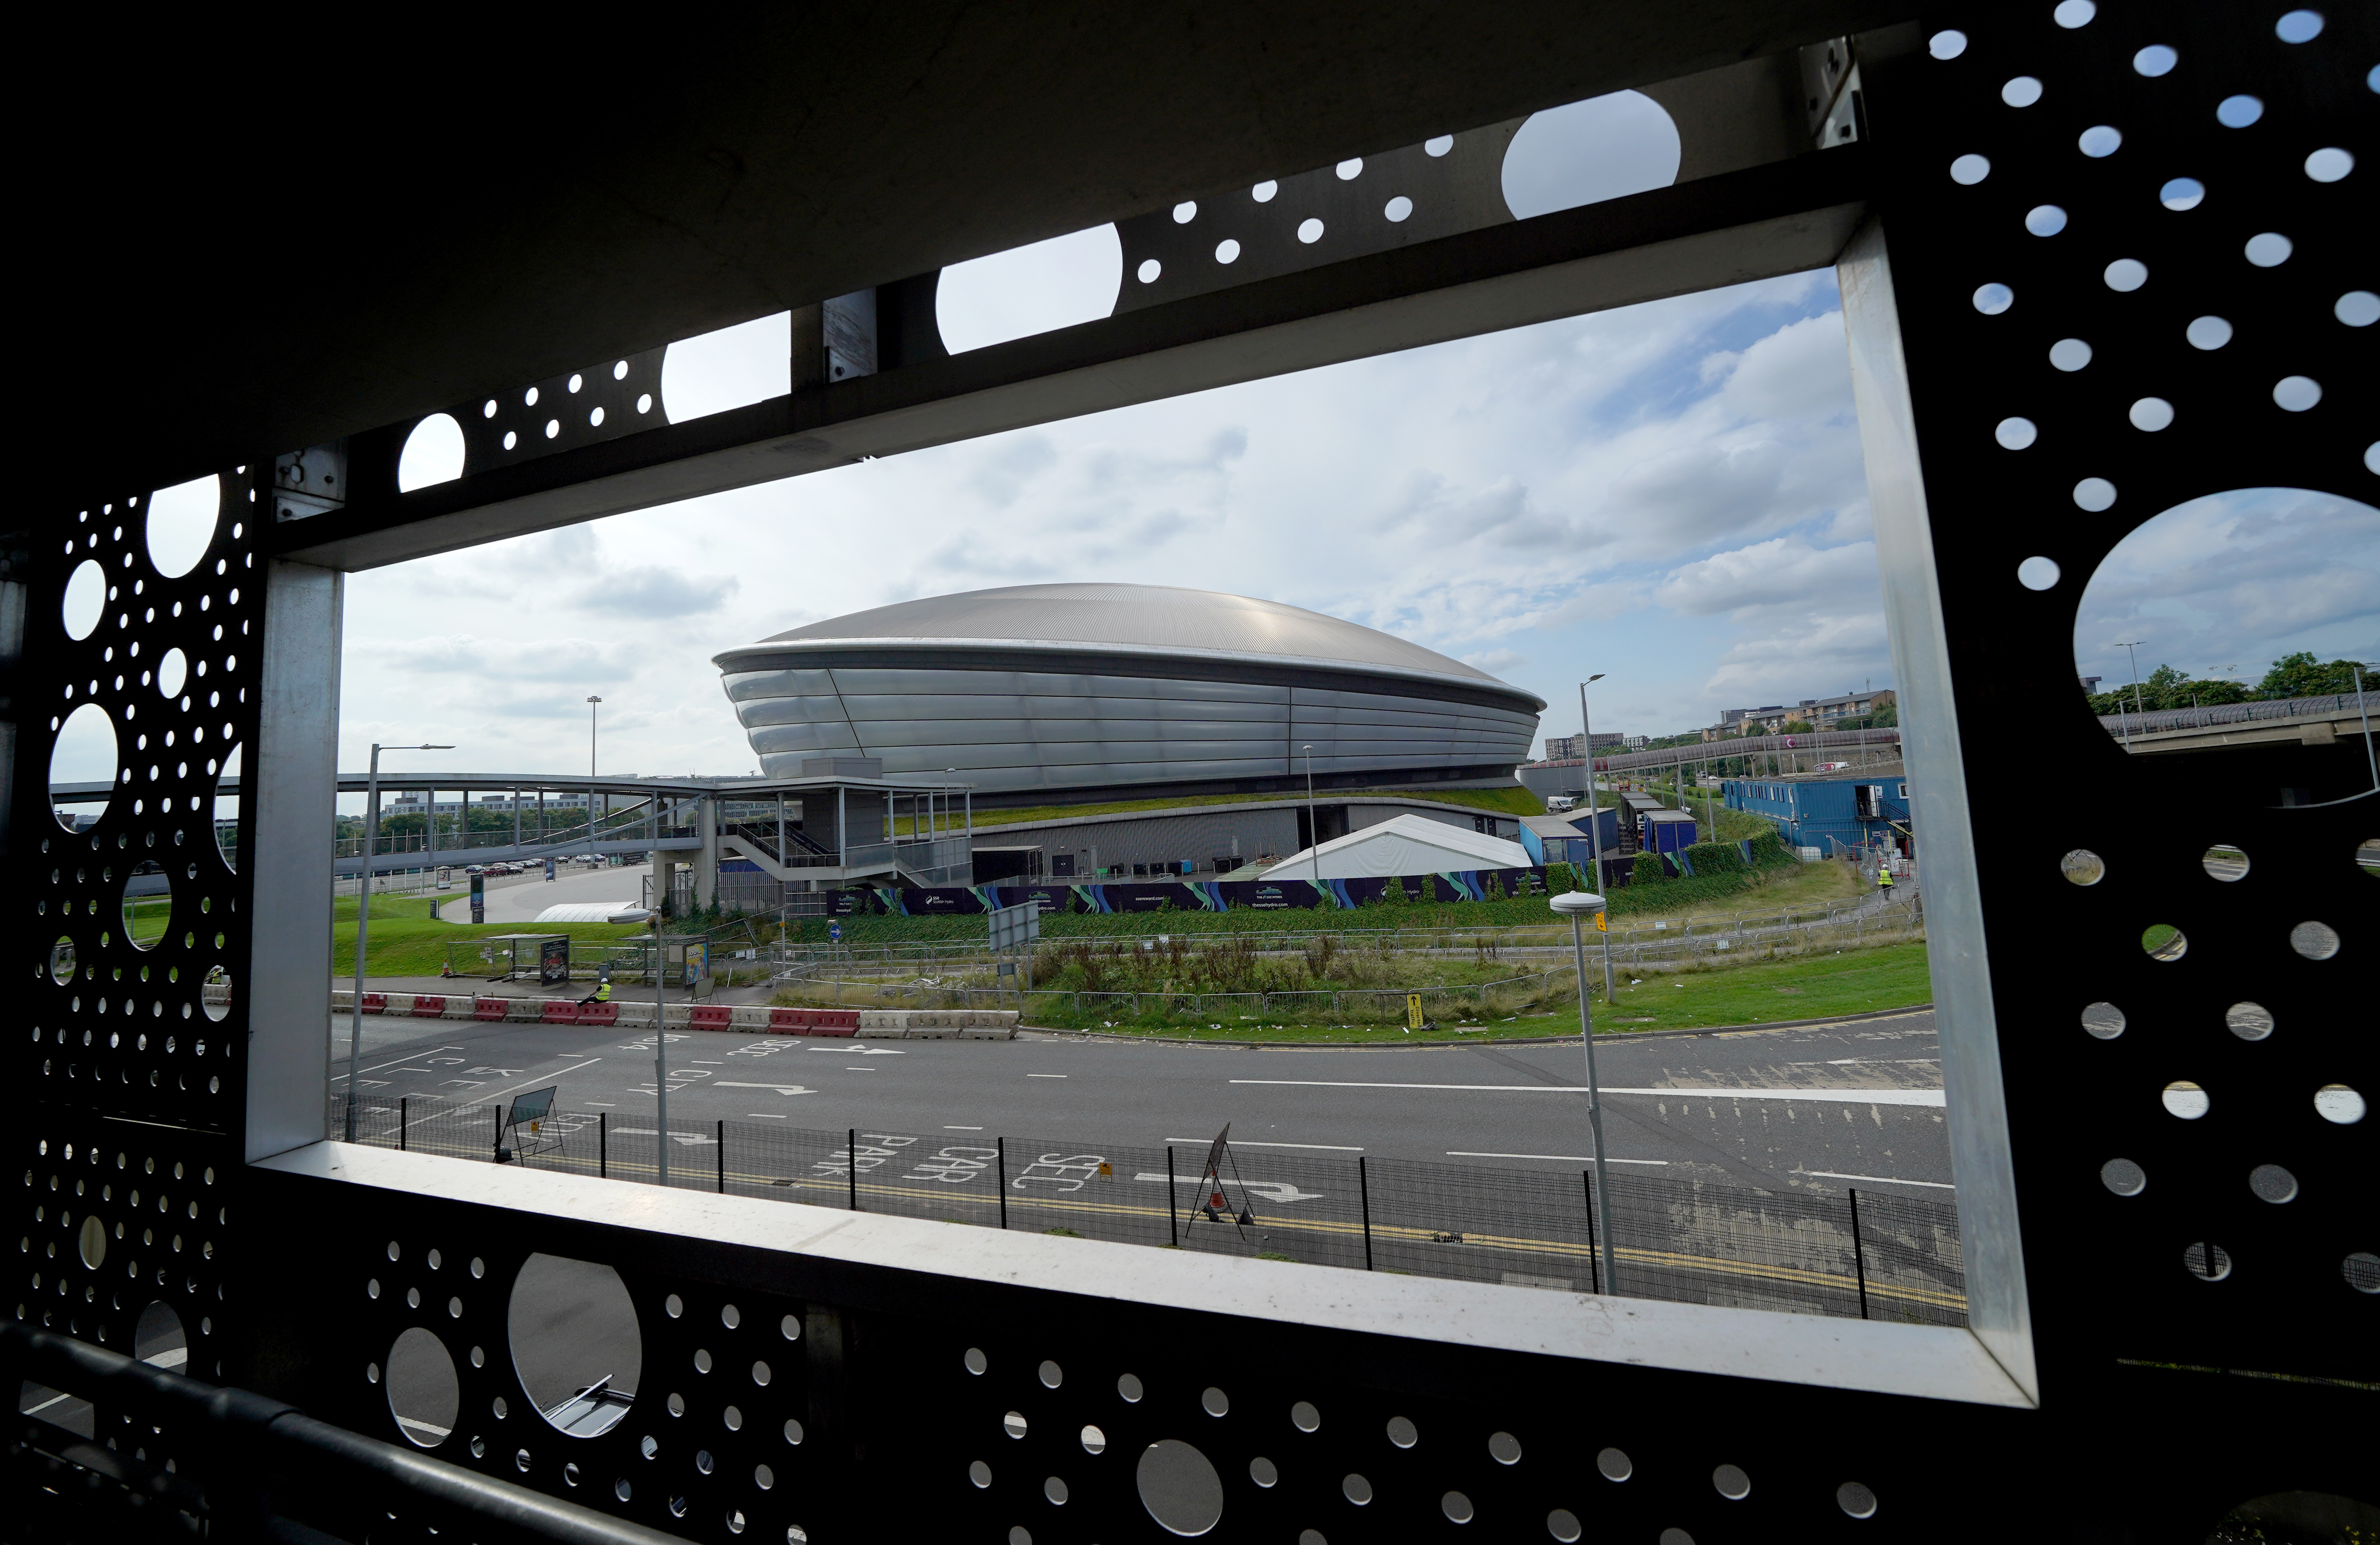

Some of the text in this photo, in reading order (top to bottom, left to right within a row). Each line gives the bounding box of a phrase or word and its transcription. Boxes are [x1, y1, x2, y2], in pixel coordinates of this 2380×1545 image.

[617, 1033, 691, 1050] A814
[726, 1039, 802, 1057] SECC
[626, 1069, 712, 1096] CITY
[811, 1134, 918, 1177] PARK
[902, 1146, 999, 1183] CAR
[1012, 1153, 1105, 1192] SEC
